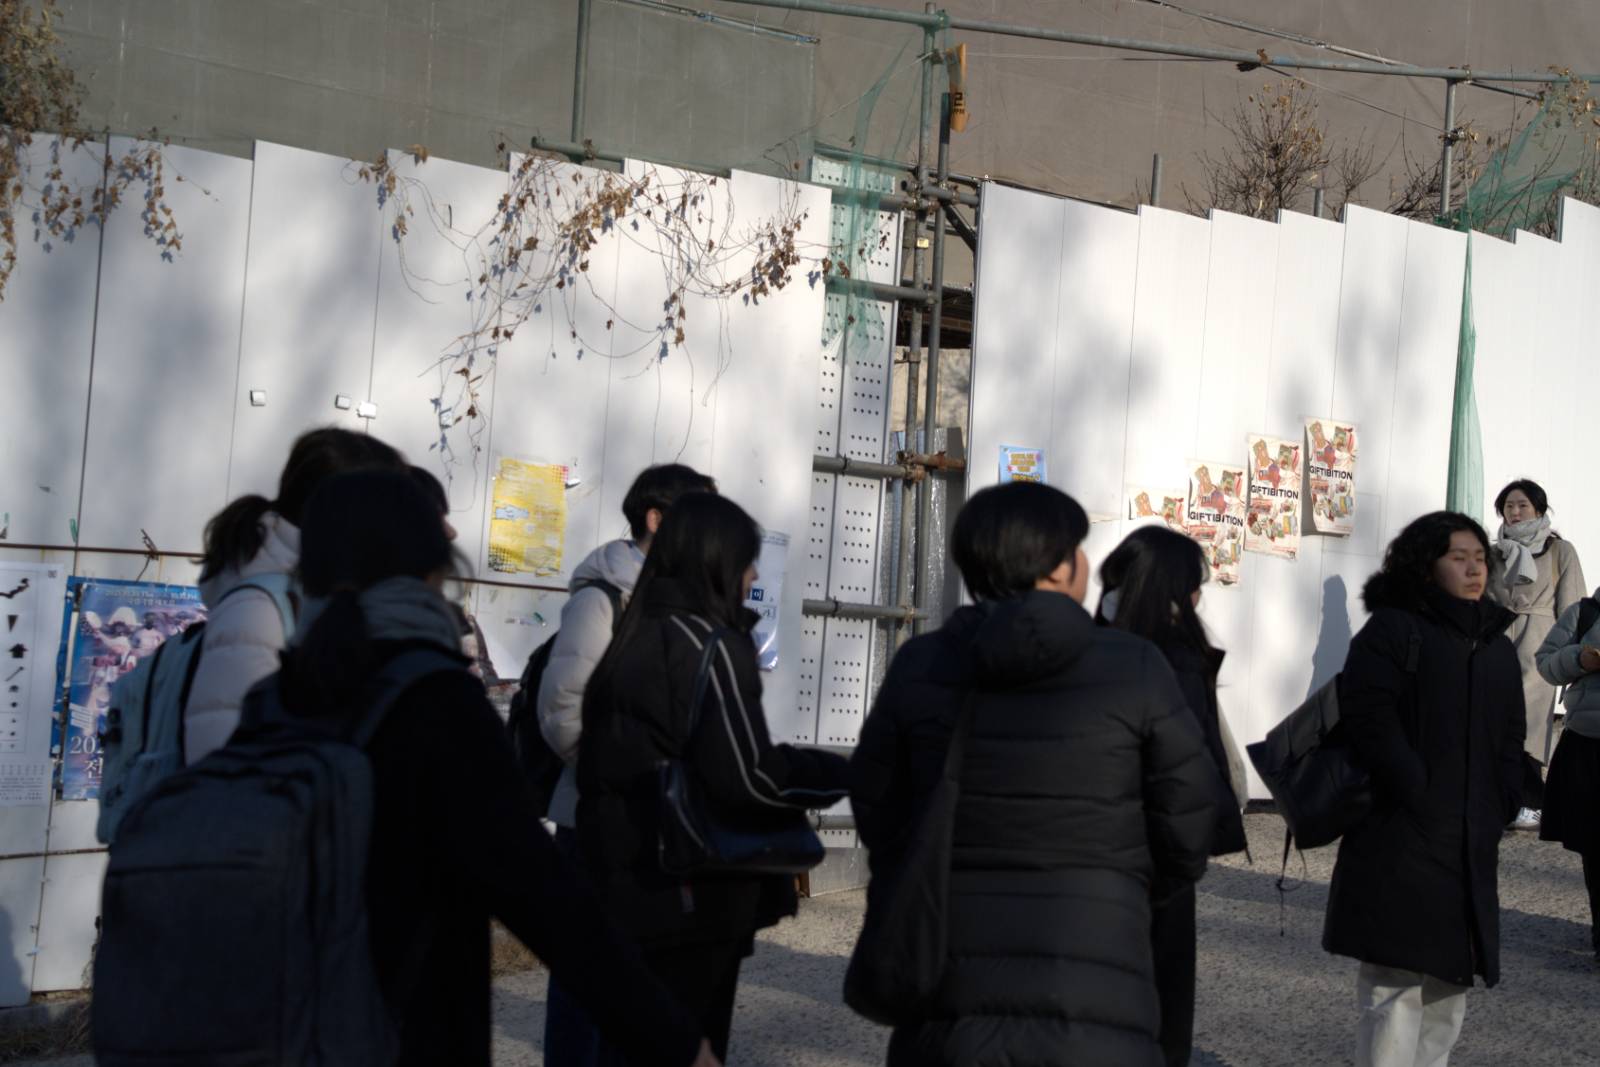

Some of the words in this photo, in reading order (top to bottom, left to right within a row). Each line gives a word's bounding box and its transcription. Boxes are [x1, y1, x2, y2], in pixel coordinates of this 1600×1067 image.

[1309, 465, 1353, 480] GIFTIBITION
[1250, 485, 1299, 500] GIFTIBITION
[1190, 511, 1244, 527] GIFTIBITION
